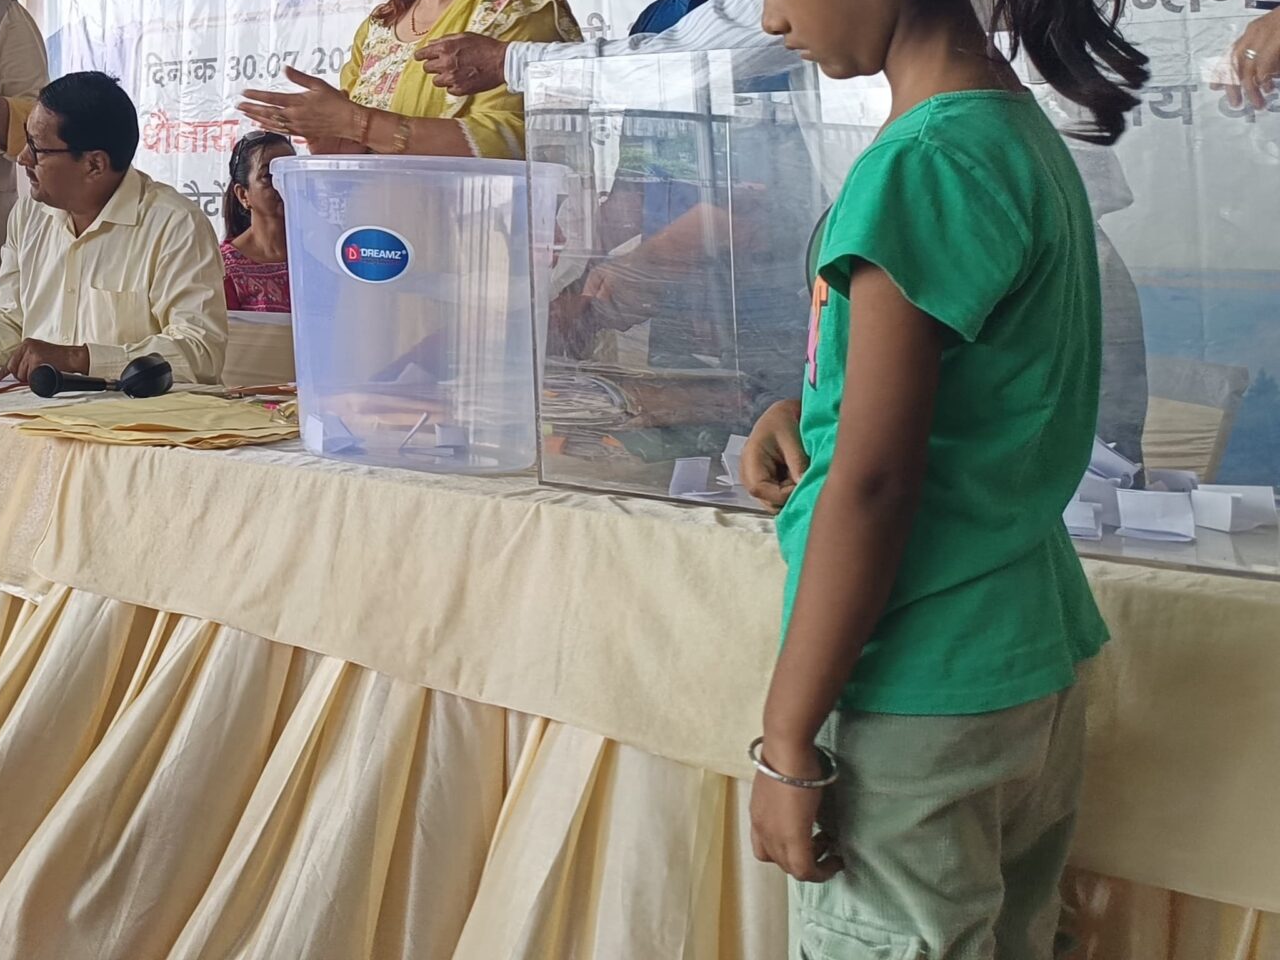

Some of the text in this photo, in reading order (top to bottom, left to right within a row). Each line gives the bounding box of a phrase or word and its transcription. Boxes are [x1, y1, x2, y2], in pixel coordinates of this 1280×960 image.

[145, 46, 352, 88] दिनांक 30.07.20
[360, 247, 402, 261] DREAMZ
